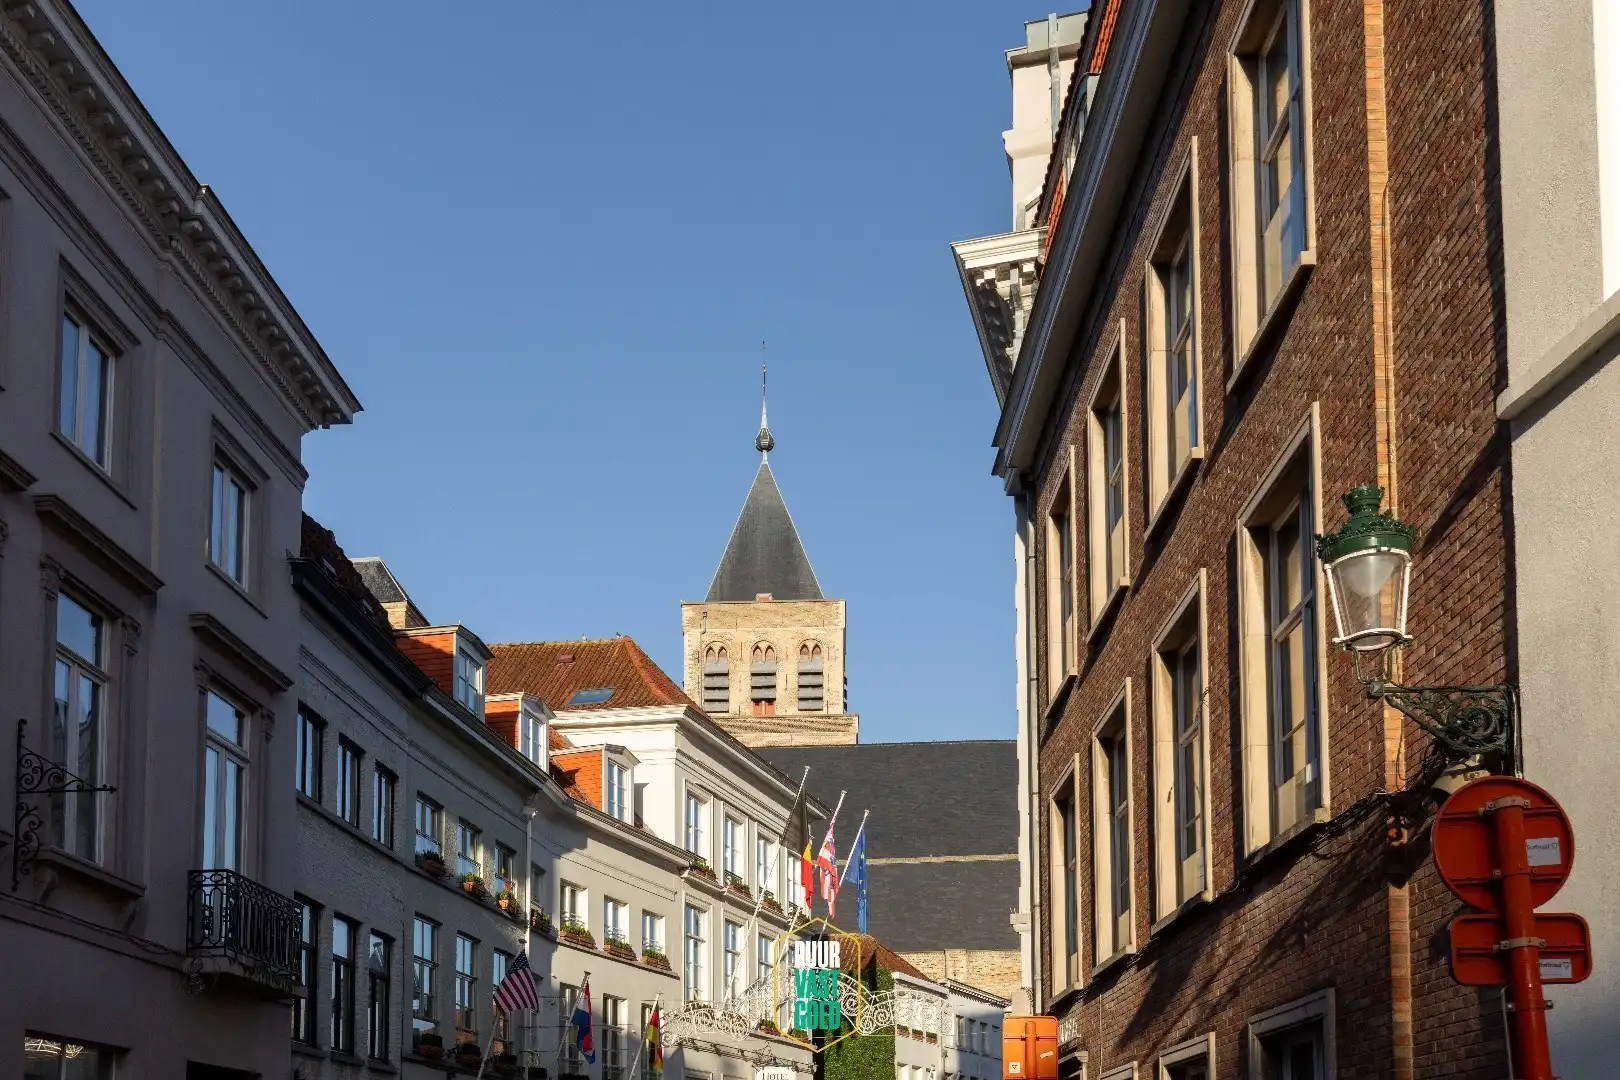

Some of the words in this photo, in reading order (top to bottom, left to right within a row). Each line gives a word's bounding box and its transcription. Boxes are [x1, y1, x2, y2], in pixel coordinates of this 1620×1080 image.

[794, 940, 841, 968] PUUR
[793, 969, 841, 998] VAST
[794, 1000, 841, 1030] GOED
